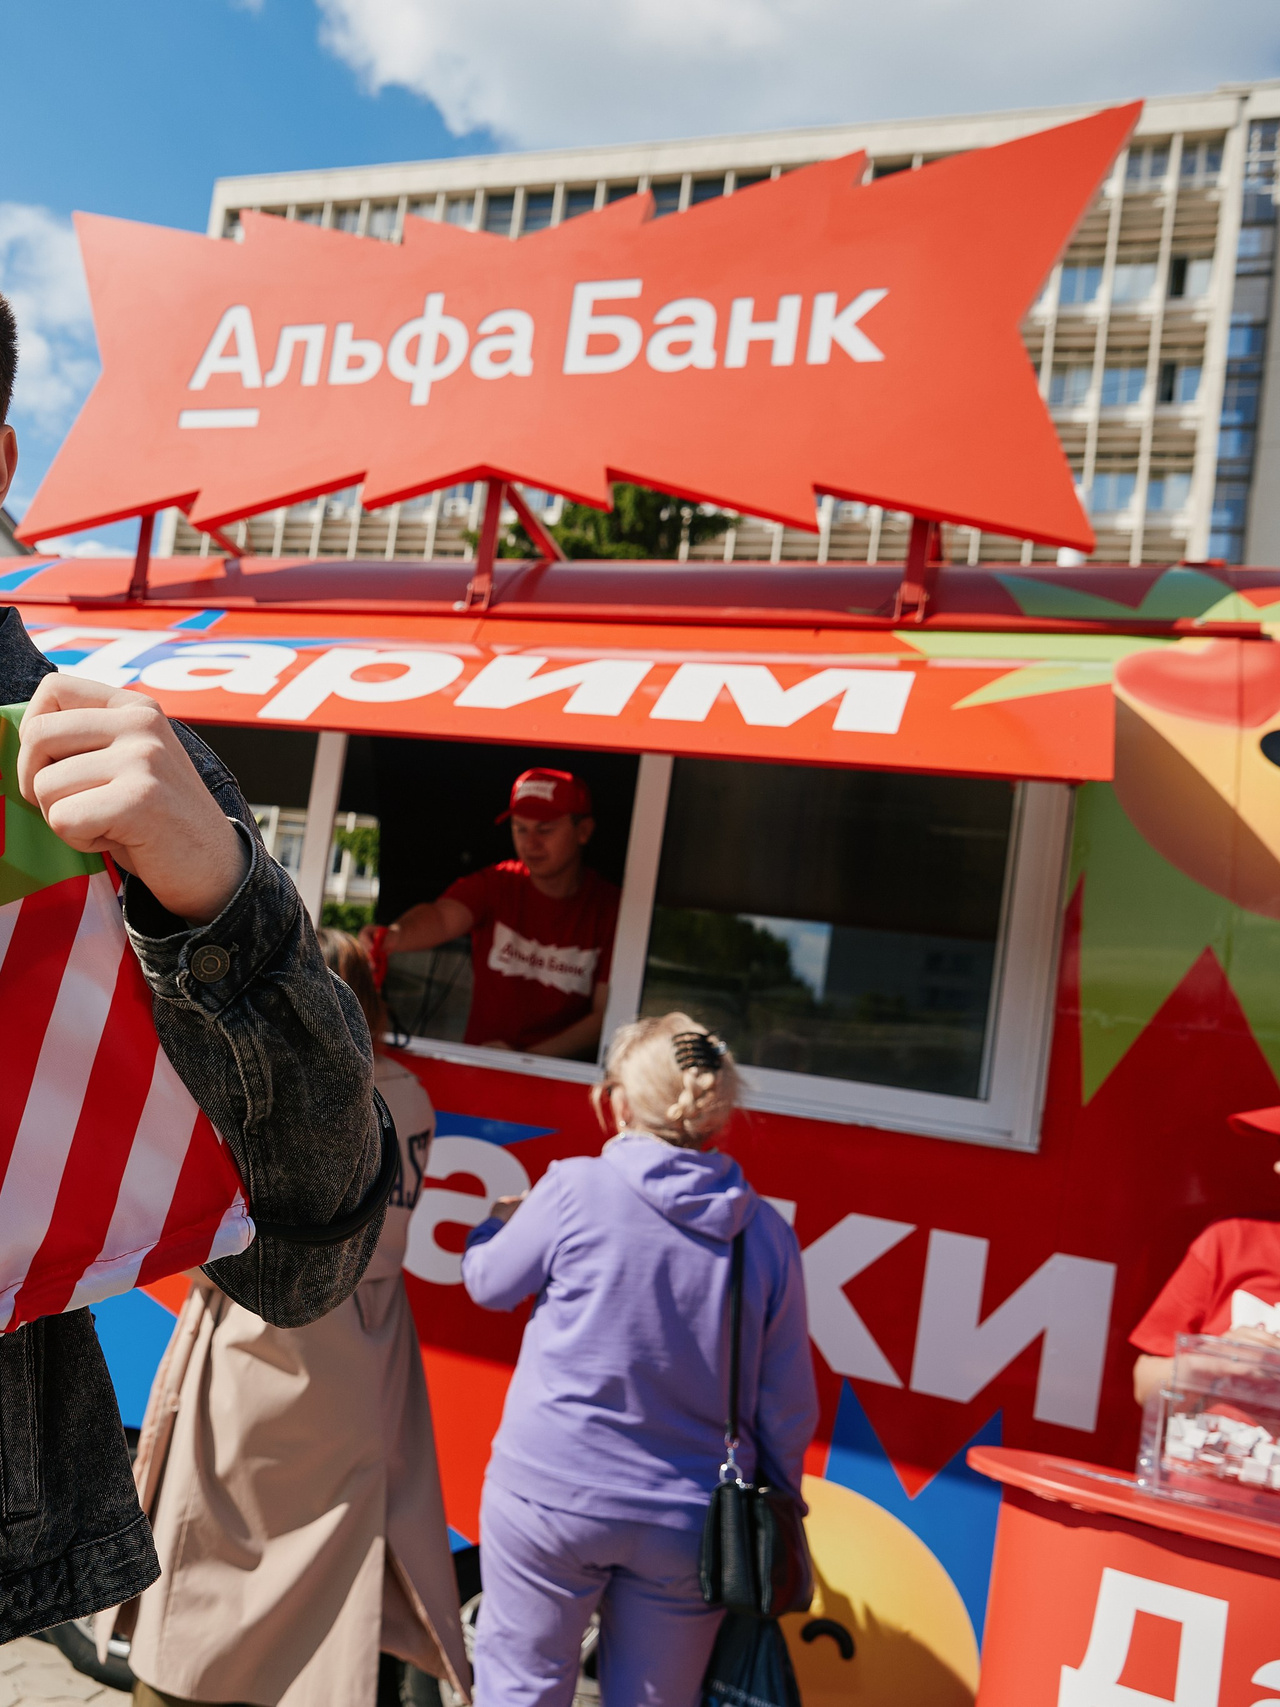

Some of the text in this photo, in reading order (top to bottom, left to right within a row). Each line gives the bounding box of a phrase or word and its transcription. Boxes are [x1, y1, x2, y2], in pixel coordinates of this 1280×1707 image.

[186, 278, 888, 405] Альфа Банк
[30, 625, 916, 734] Дарим
